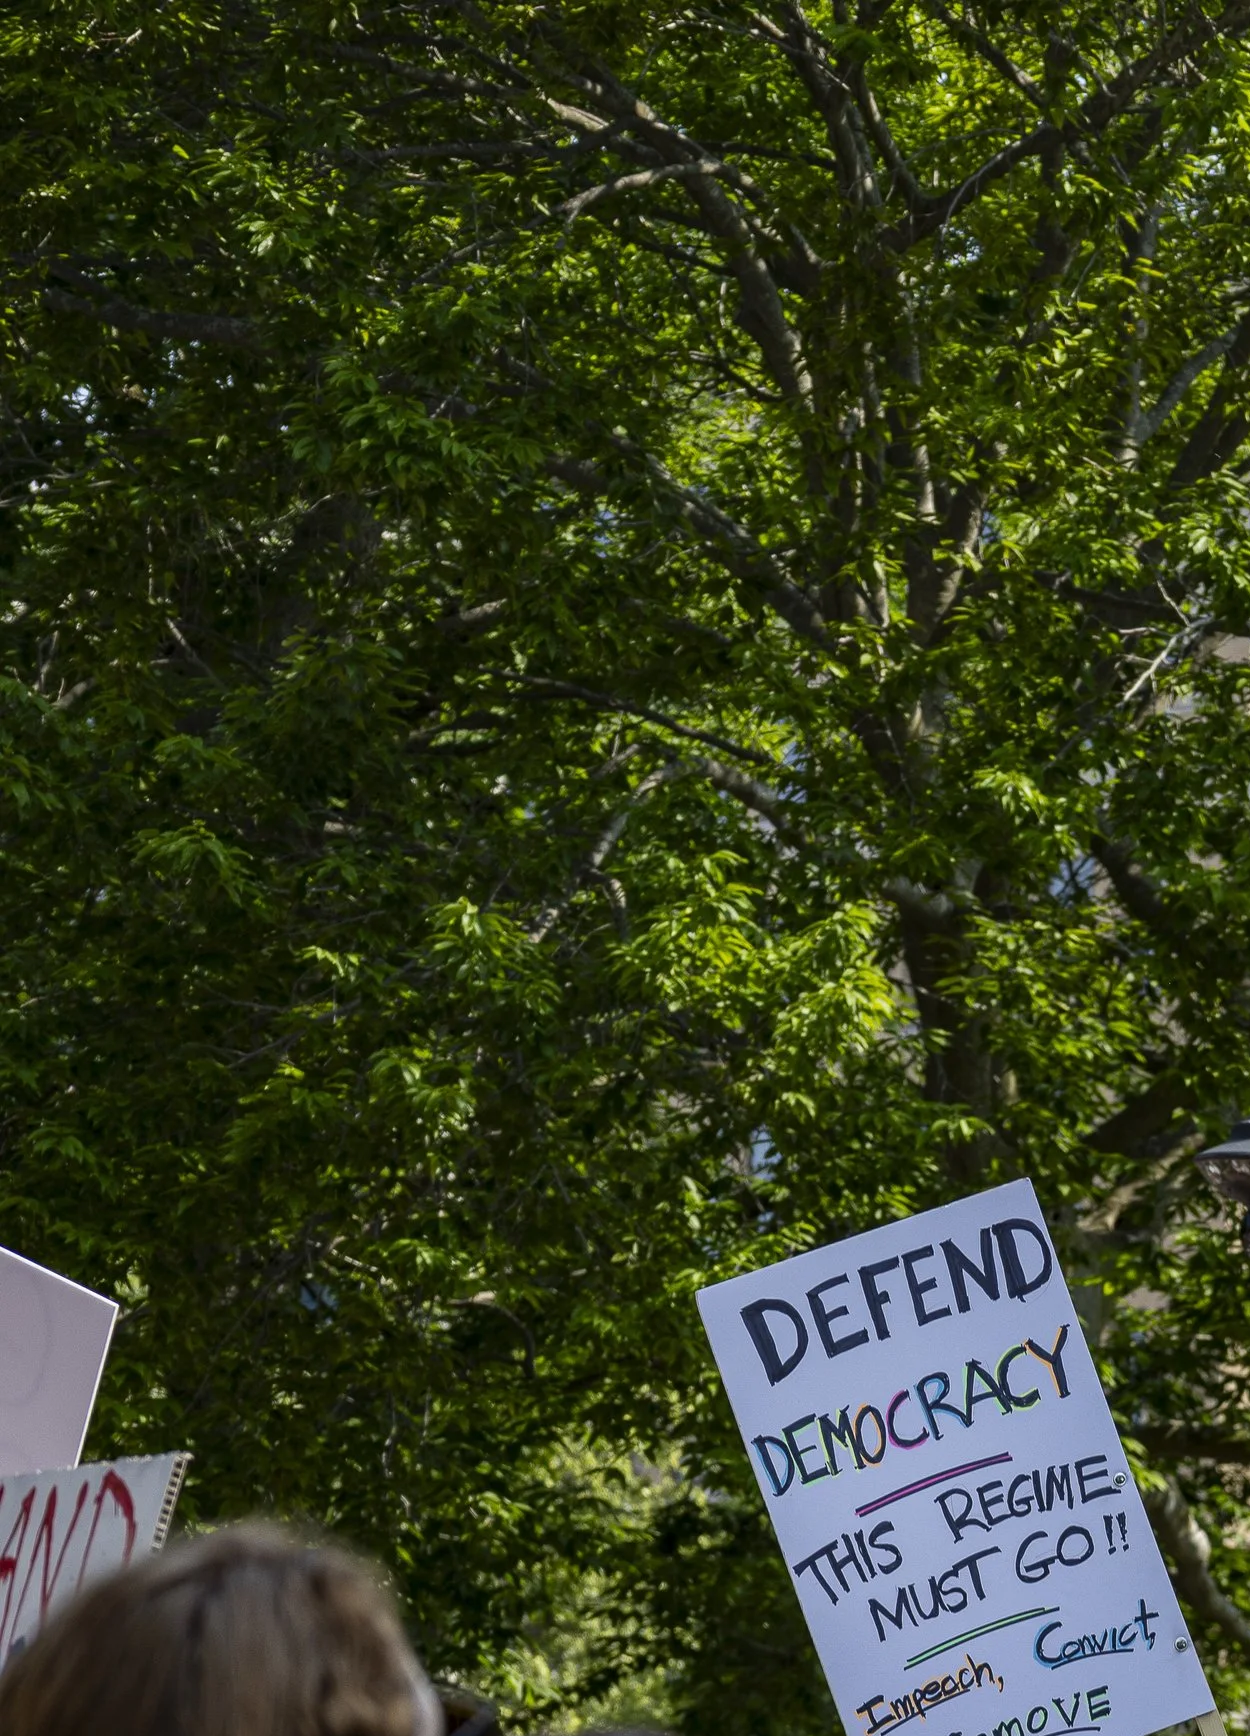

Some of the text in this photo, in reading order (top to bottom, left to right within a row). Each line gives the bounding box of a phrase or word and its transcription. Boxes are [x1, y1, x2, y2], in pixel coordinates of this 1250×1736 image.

[740, 1218, 1053, 1386] DEFEND
[751, 1324, 1070, 1497] DEMOCRACY
[793, 1455, 1121, 1605] THIS REGIME
[868, 1546, 1002, 1642] MUST
[856, 1653, 1004, 1736] Impeach,
